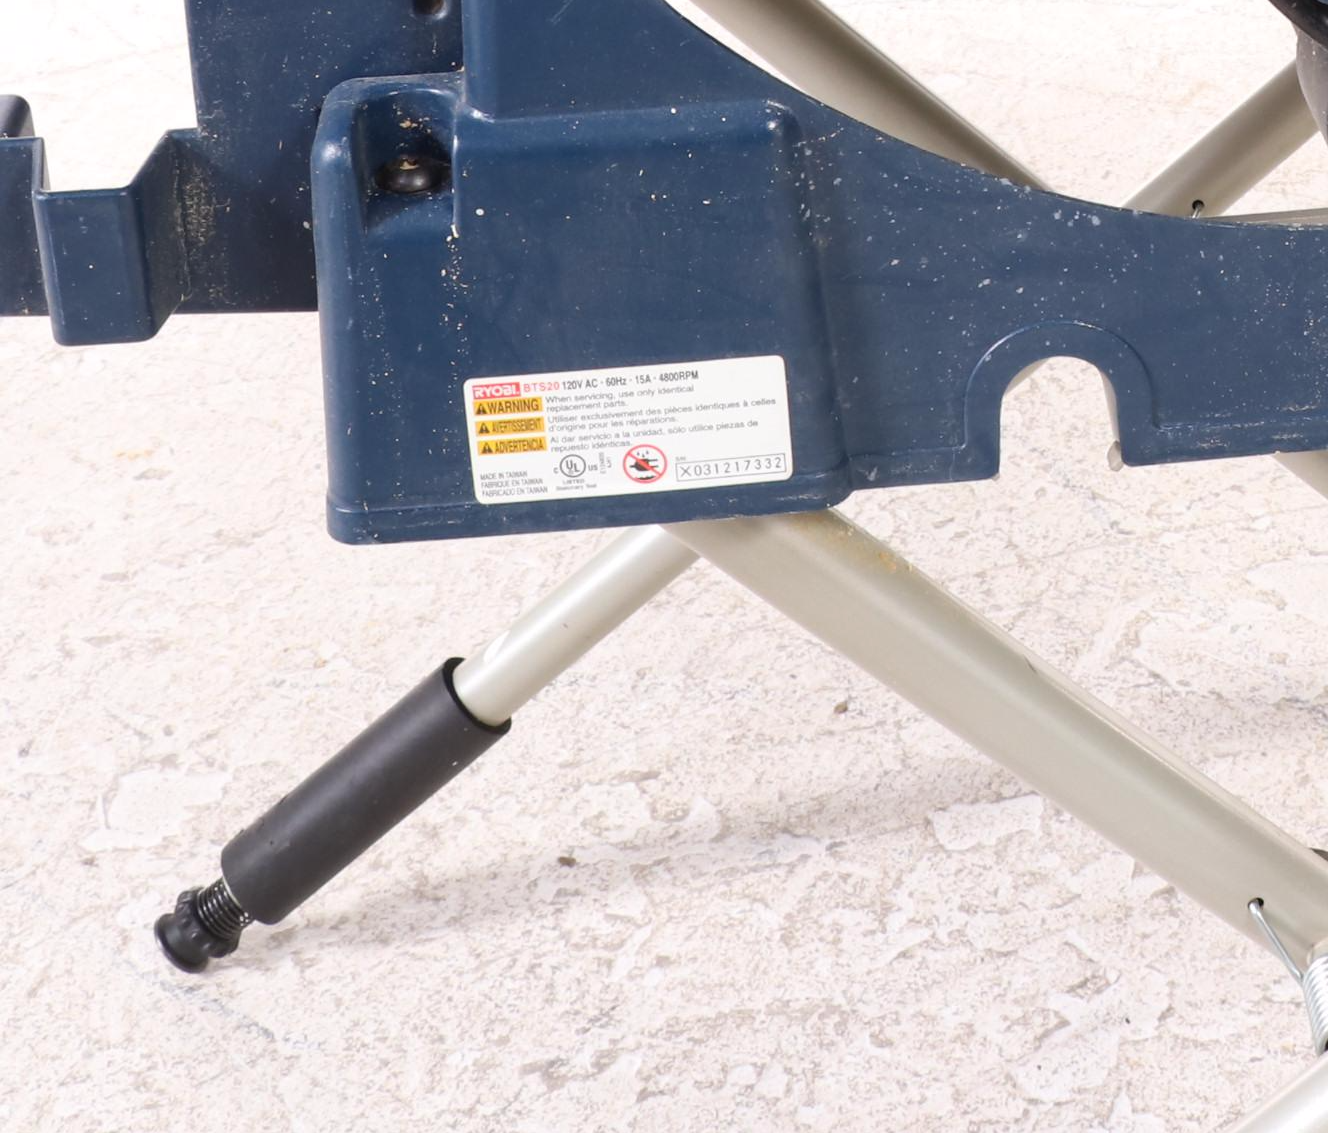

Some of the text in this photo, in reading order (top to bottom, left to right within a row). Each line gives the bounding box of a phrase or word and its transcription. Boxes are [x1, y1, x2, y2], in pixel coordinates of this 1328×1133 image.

[523, 382, 560, 393] BTS20
[563, 380, 583, 390] 120V
[585, 378, 598, 388] AC
[606, 376, 627, 387] 60Hz
[635, 374, 651, 384] 15A
[659, 370, 699, 382] 4800RPM
[546, 395, 571, 403] When
[575, 391, 614, 402] servicing,
[637, 388, 655, 398] only
[658, 384, 695, 395] identical
[487, 399, 539, 414] WARNING
[546, 400, 628, 413] replacement parts.
[548, 415, 577, 424] Utiliser
[581, 410, 643, 421] exclusivement
[645, 408, 662, 416] des
[664, 404, 693, 416] pièces
[695, 401, 740, 412] identiques
[751, 397, 777, 407] celles
[492, 418, 541, 433] AVERTISSEMENT
[589, 421, 608, 431] pour
[611, 420, 624, 428] les
[626, 416, 678, 428] réparations.
[561, 435, 575, 444] dar
[578, 433, 612, 442] servicio
[622, 429, 630, 438] la
[668, 425, 686, 435] sólo
[688, 423, 714, 433] utilice
[716, 421, 745, 432] piezas
[494, 440, 544, 454] ADVERTENCIA
[551, 443, 589, 454] repuesto
[565, 459, 580, 472] UL
[680, 457, 782, 477] X031217332
[506, 470, 528, 479] TAIWAN
[481, 478, 544, 489] FABRIQUE EN TAIWAN
[482, 488, 516, 498] FABRICADO
[517, 487, 525, 495] EN
[527, 485, 548, 495] TAIWAN
